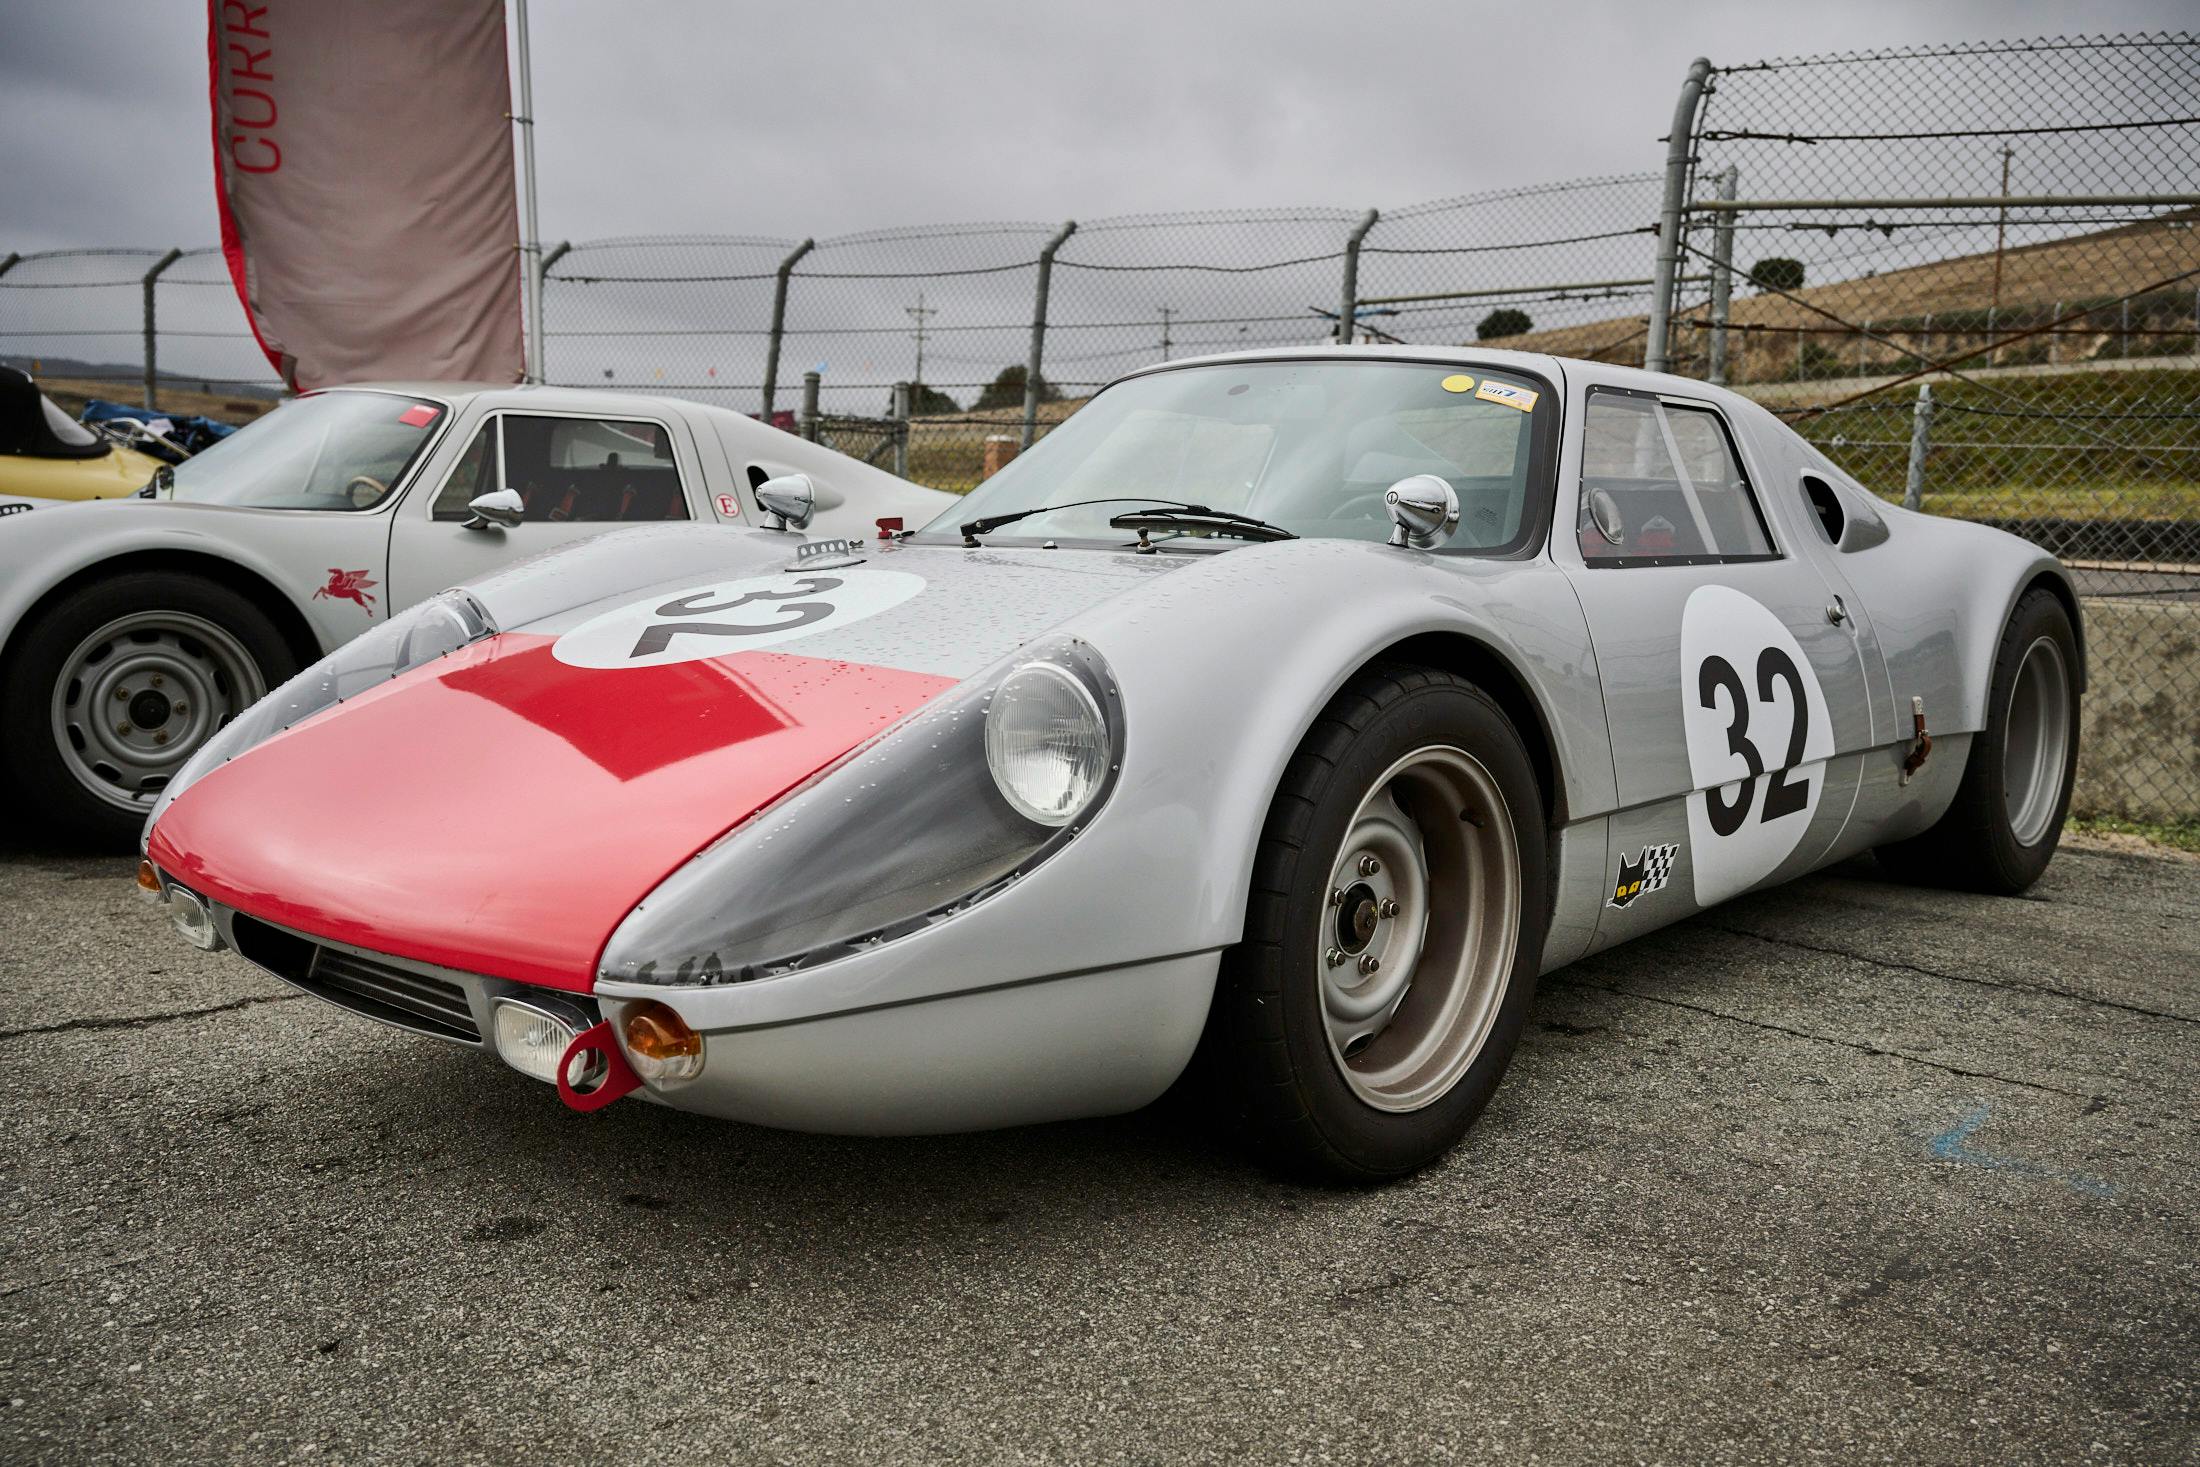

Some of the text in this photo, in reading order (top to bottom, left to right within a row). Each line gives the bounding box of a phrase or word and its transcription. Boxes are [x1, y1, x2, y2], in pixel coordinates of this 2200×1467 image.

[223, 0, 282, 174] CURR
[719, 497, 735, 515] E
[629, 577, 844, 658] 32
[1698, 646, 1810, 837] 32
